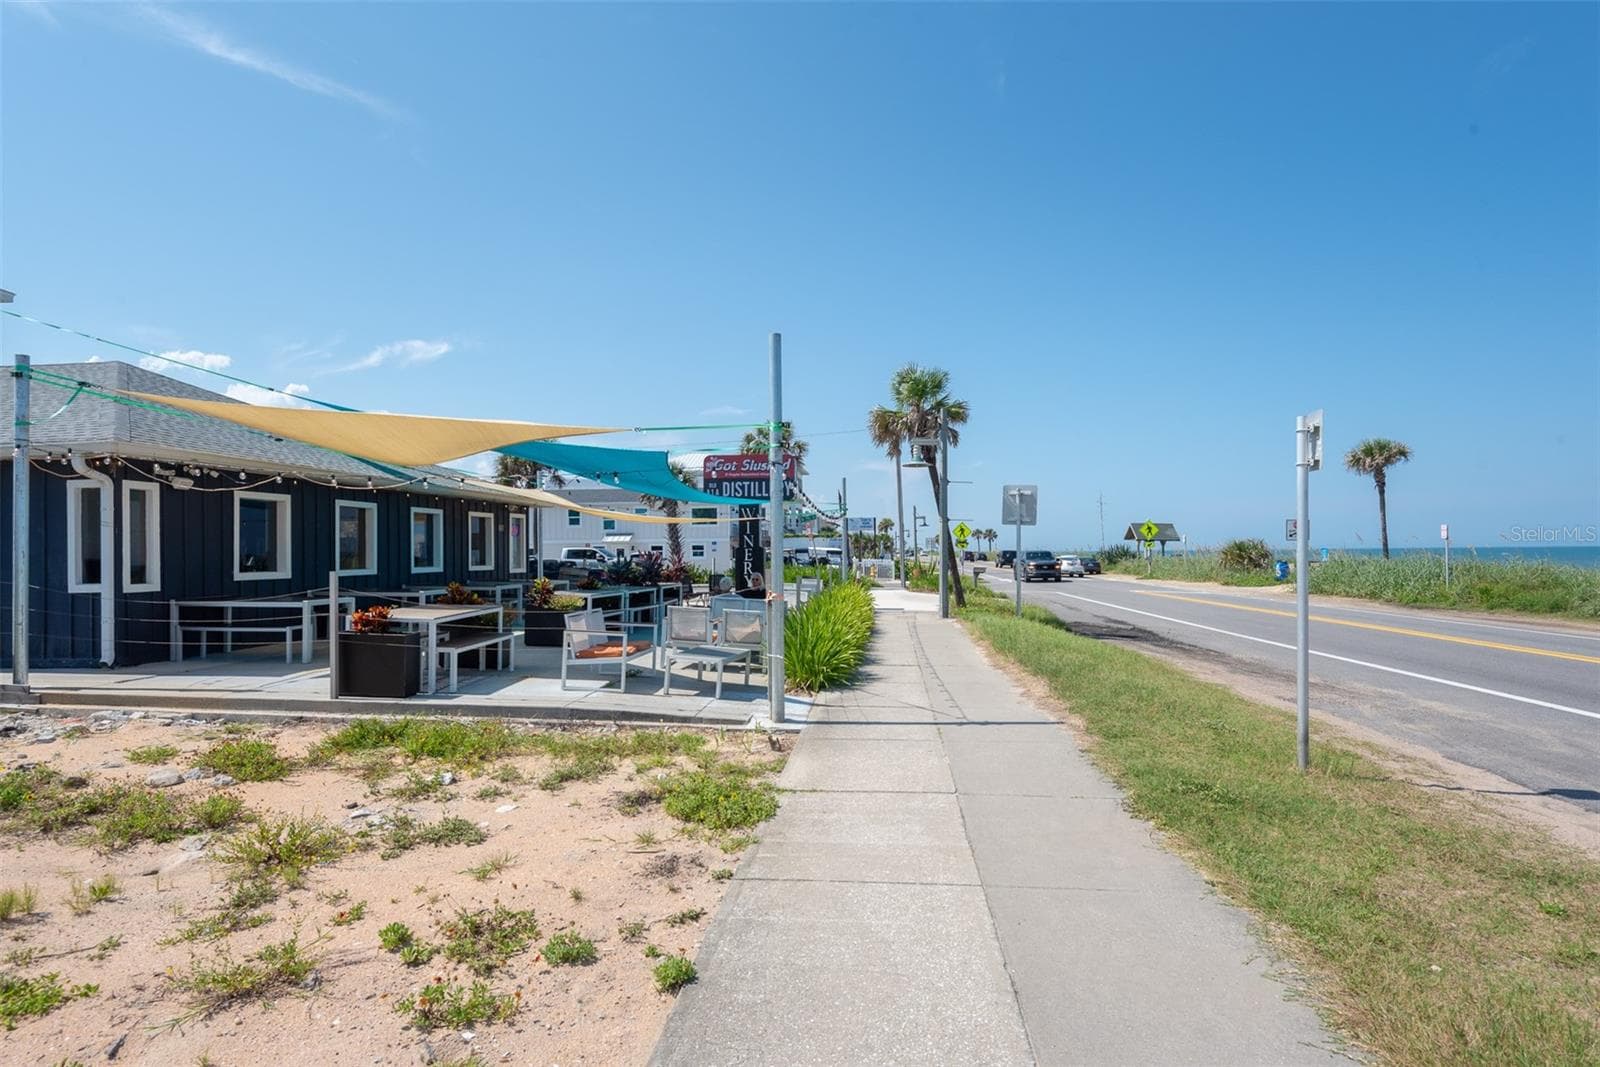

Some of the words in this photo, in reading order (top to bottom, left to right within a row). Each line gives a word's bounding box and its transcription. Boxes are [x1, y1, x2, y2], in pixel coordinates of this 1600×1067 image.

[714, 459, 738, 471] Got
[741, 458, 791, 471] Slusd
[722, 481, 790, 497] DISTILLY
[741, 507, 756, 588] WINERY
